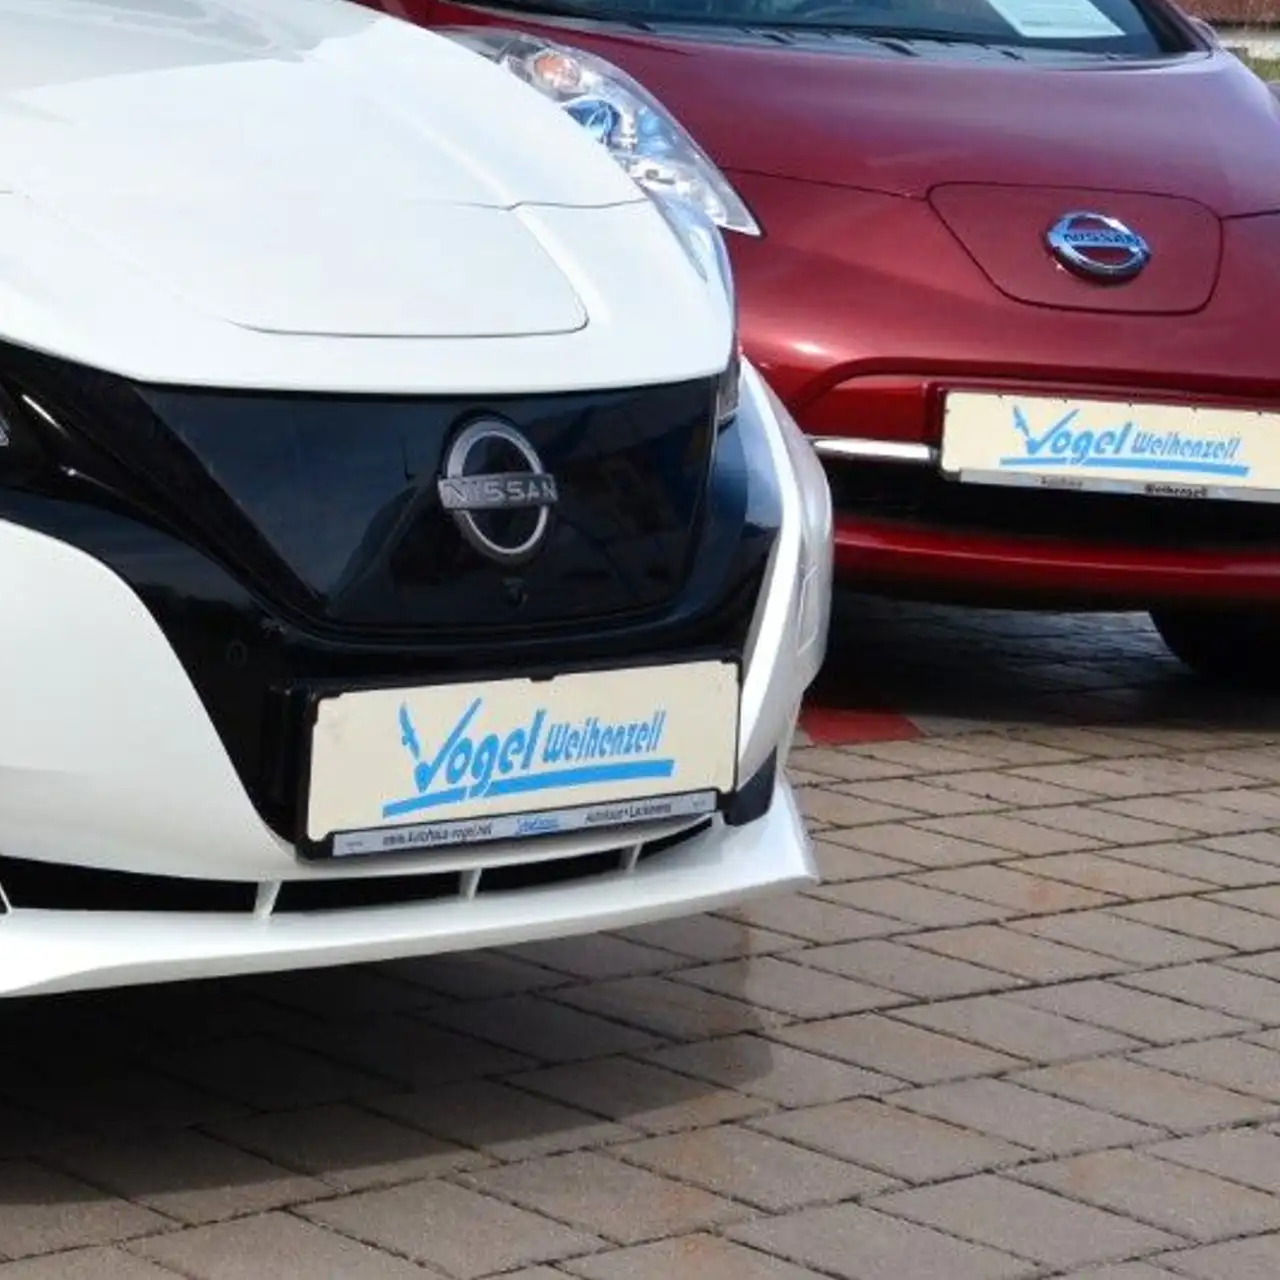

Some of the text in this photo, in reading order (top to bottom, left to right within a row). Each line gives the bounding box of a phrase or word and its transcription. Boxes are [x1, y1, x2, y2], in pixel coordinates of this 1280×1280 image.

[1013, 405, 1241, 465] Vogel Weihenzell
[442, 477, 559, 506] NISSAN
[399, 697, 667, 797] Vogel Weihenzell
